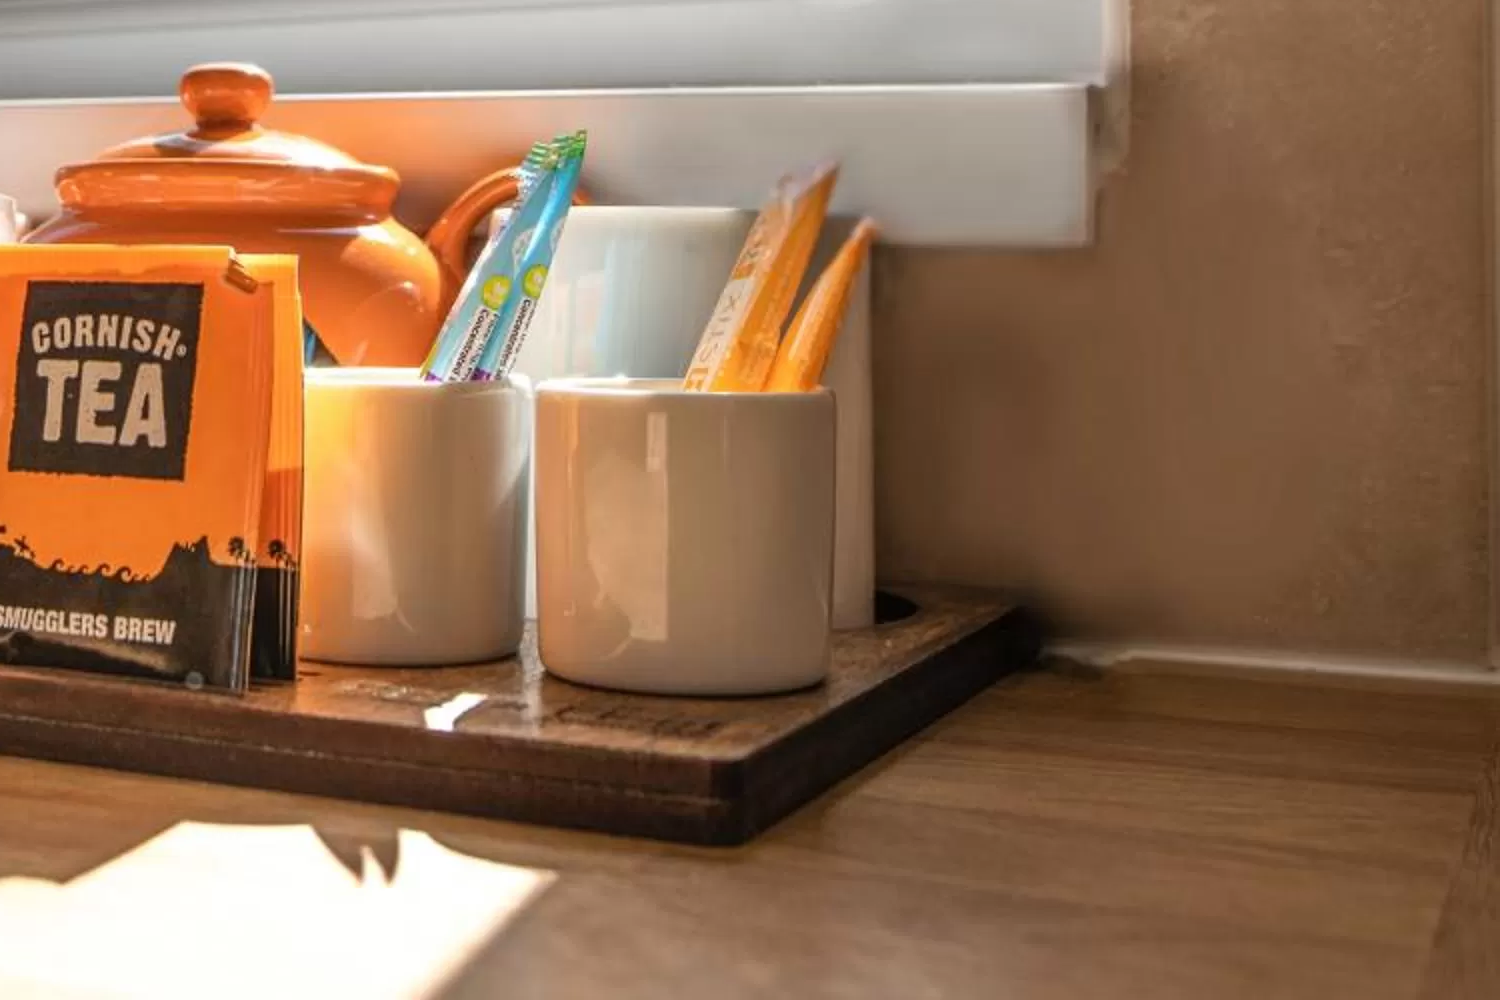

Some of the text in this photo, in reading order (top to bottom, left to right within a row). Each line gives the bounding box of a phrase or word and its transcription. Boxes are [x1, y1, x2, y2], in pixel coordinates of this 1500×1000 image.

[32, 314, 181, 361] CORNISH
[36, 359, 167, 448] TEA
[114, 616, 176, 645] BREW
